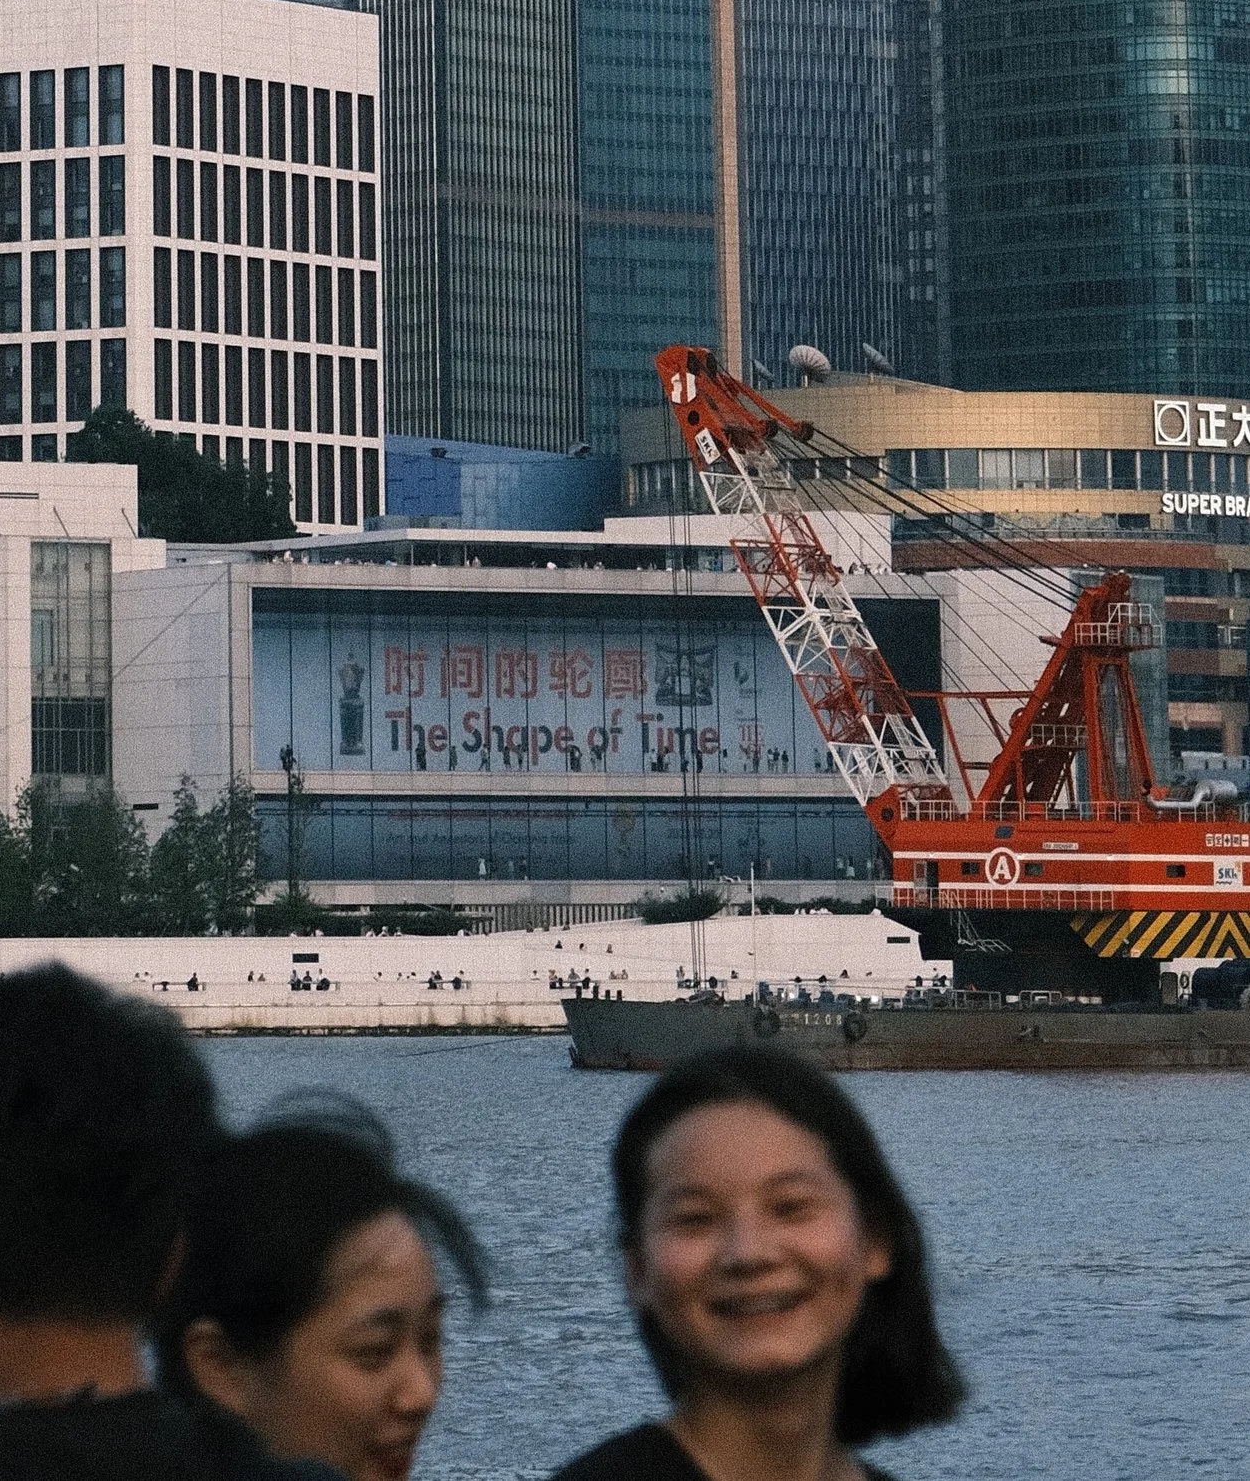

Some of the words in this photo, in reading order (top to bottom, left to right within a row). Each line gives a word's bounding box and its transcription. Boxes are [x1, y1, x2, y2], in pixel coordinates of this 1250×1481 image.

[1161, 492, 1223, 516] SUPER
[384, 645, 648, 701] 时间的轮廓
[384, 706, 448, 752] The
[462, 707, 575, 766] Shape
[586, 709, 623, 753] of
[637, 712, 720, 756] Time
